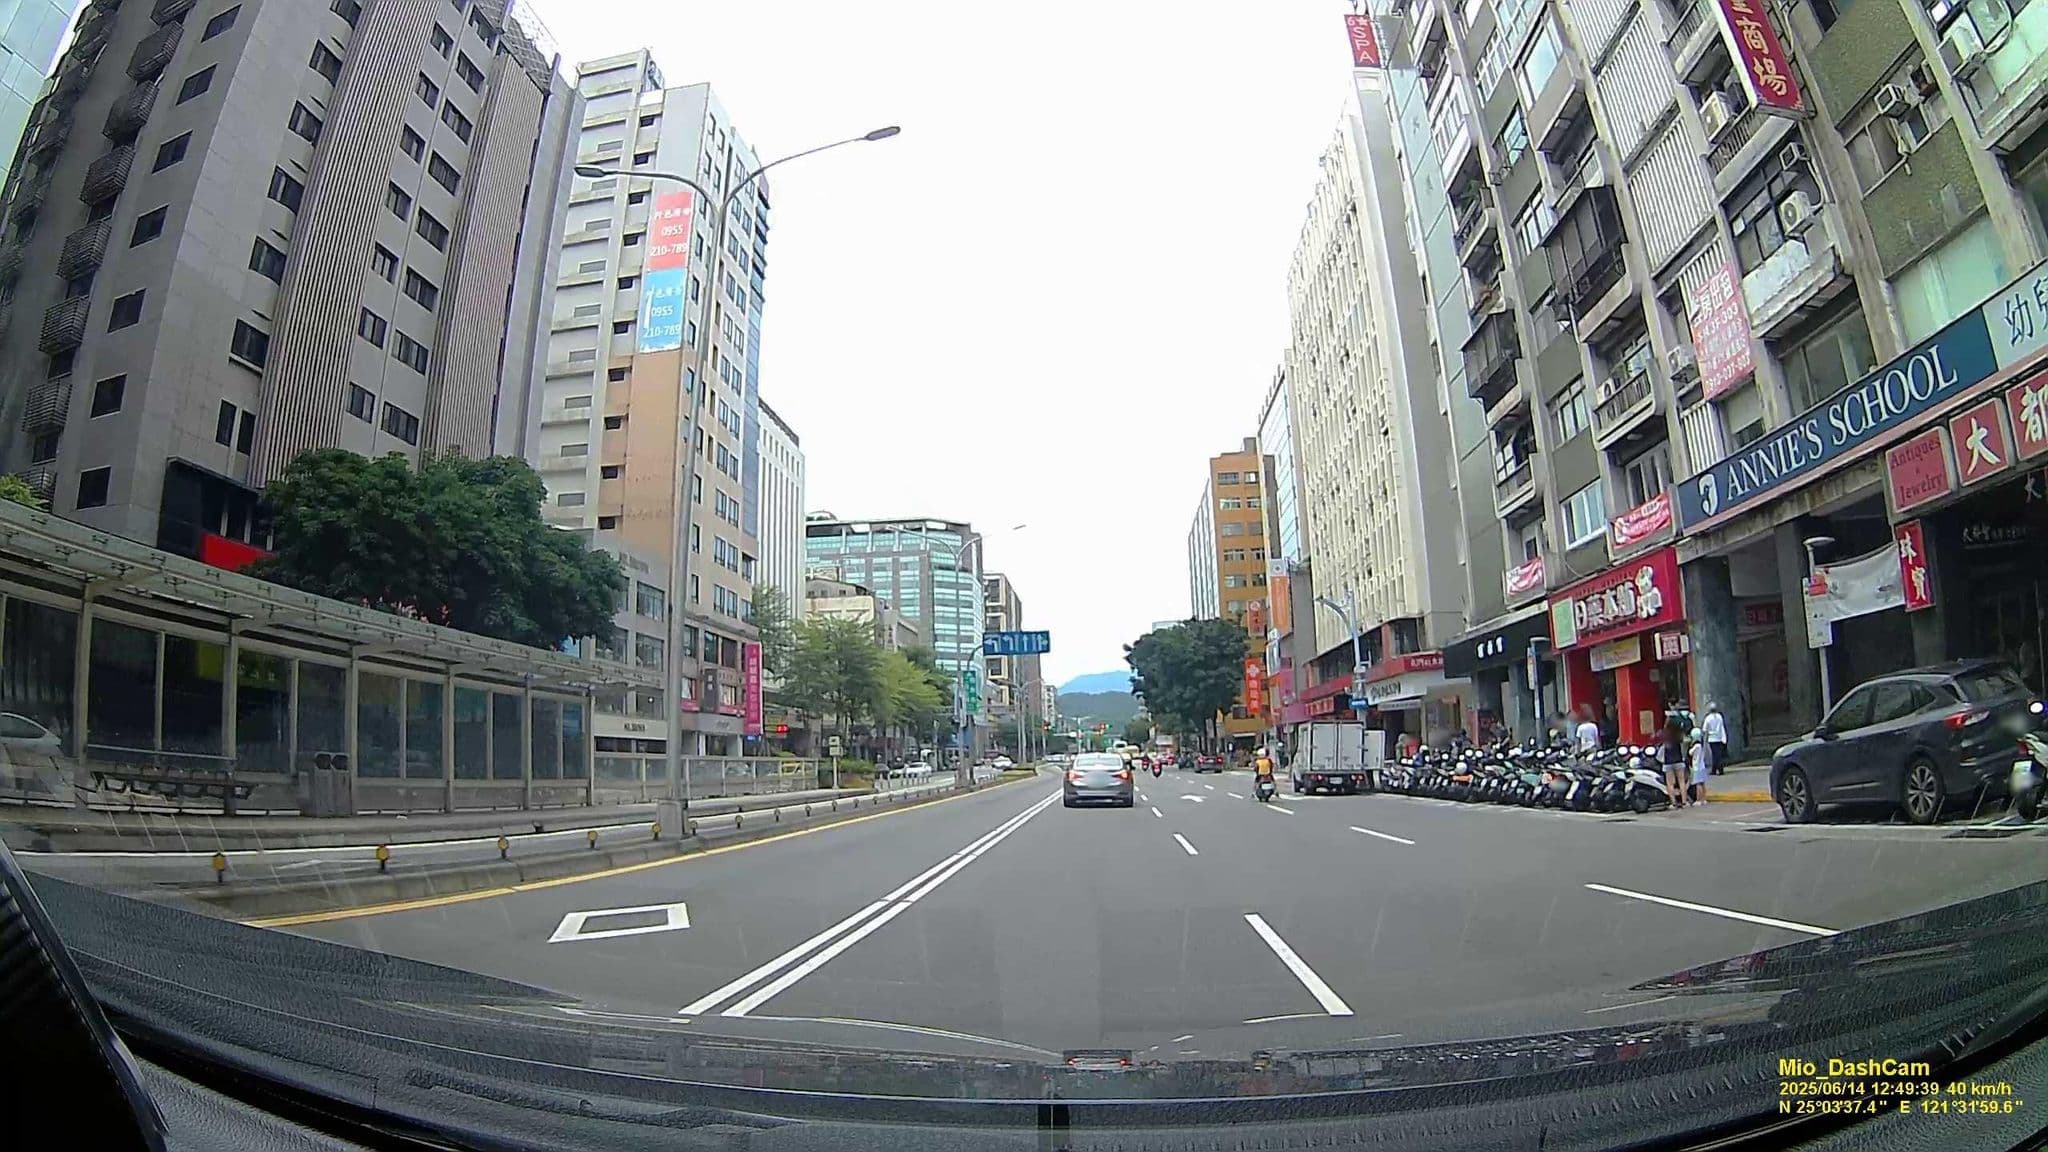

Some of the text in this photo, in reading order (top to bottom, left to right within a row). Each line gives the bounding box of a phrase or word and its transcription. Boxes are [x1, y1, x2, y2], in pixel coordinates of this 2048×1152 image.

[1352, 26, 1375, 64] SPA
[660, 224, 684, 237] 0955
[650, 242, 689, 258] 210-789
[1727, 417, 1824, 502] ANNIE'S
[1828, 343, 1959, 447] SCHOOL
[1889, 436, 1942, 469] Antiques
[1899, 472, 1945, 508] Jewelry
